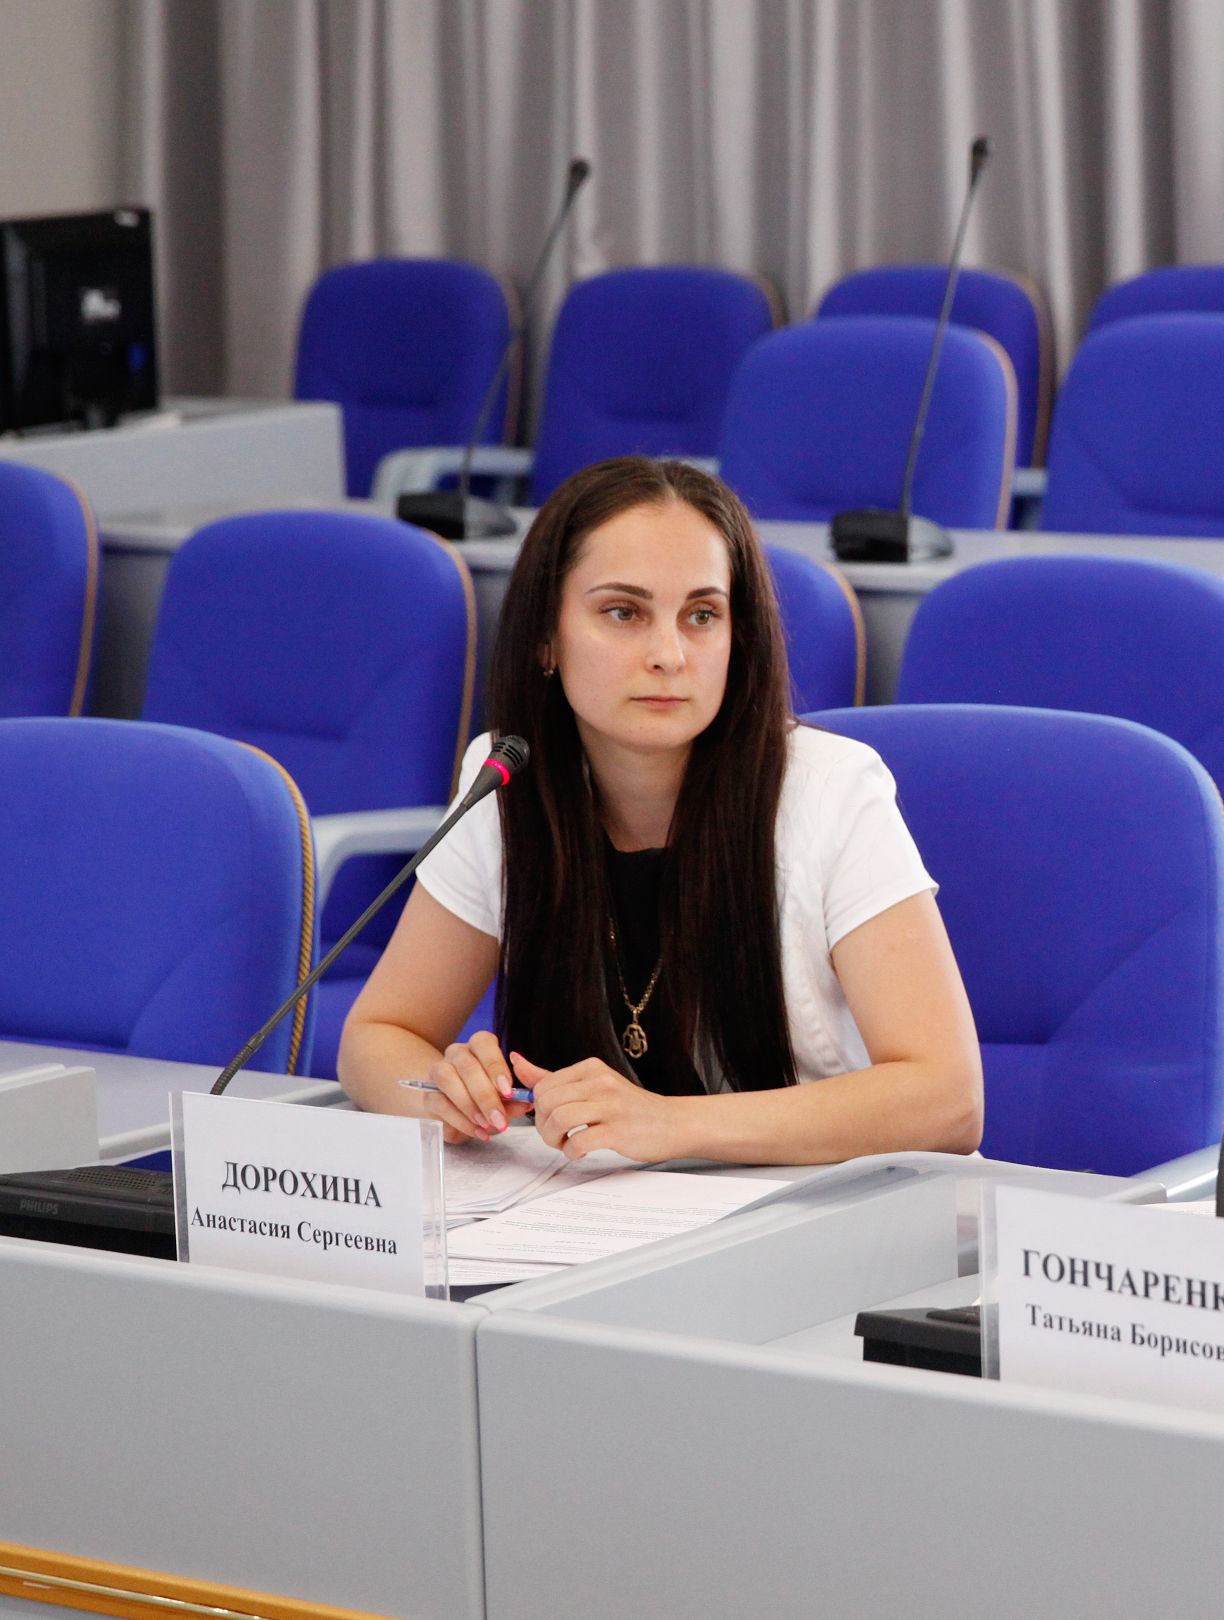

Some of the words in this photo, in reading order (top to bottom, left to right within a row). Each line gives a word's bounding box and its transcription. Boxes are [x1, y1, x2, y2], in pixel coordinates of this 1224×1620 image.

[222, 1160, 382, 1208] ДОРОХИНА
[20, 1199, 59, 1215] PHILIPS
[190, 1206, 291, 1240] Анастасия
[297, 1220, 398, 1255] Сергеевна
[1026, 1303, 1121, 1343] Татьяна
